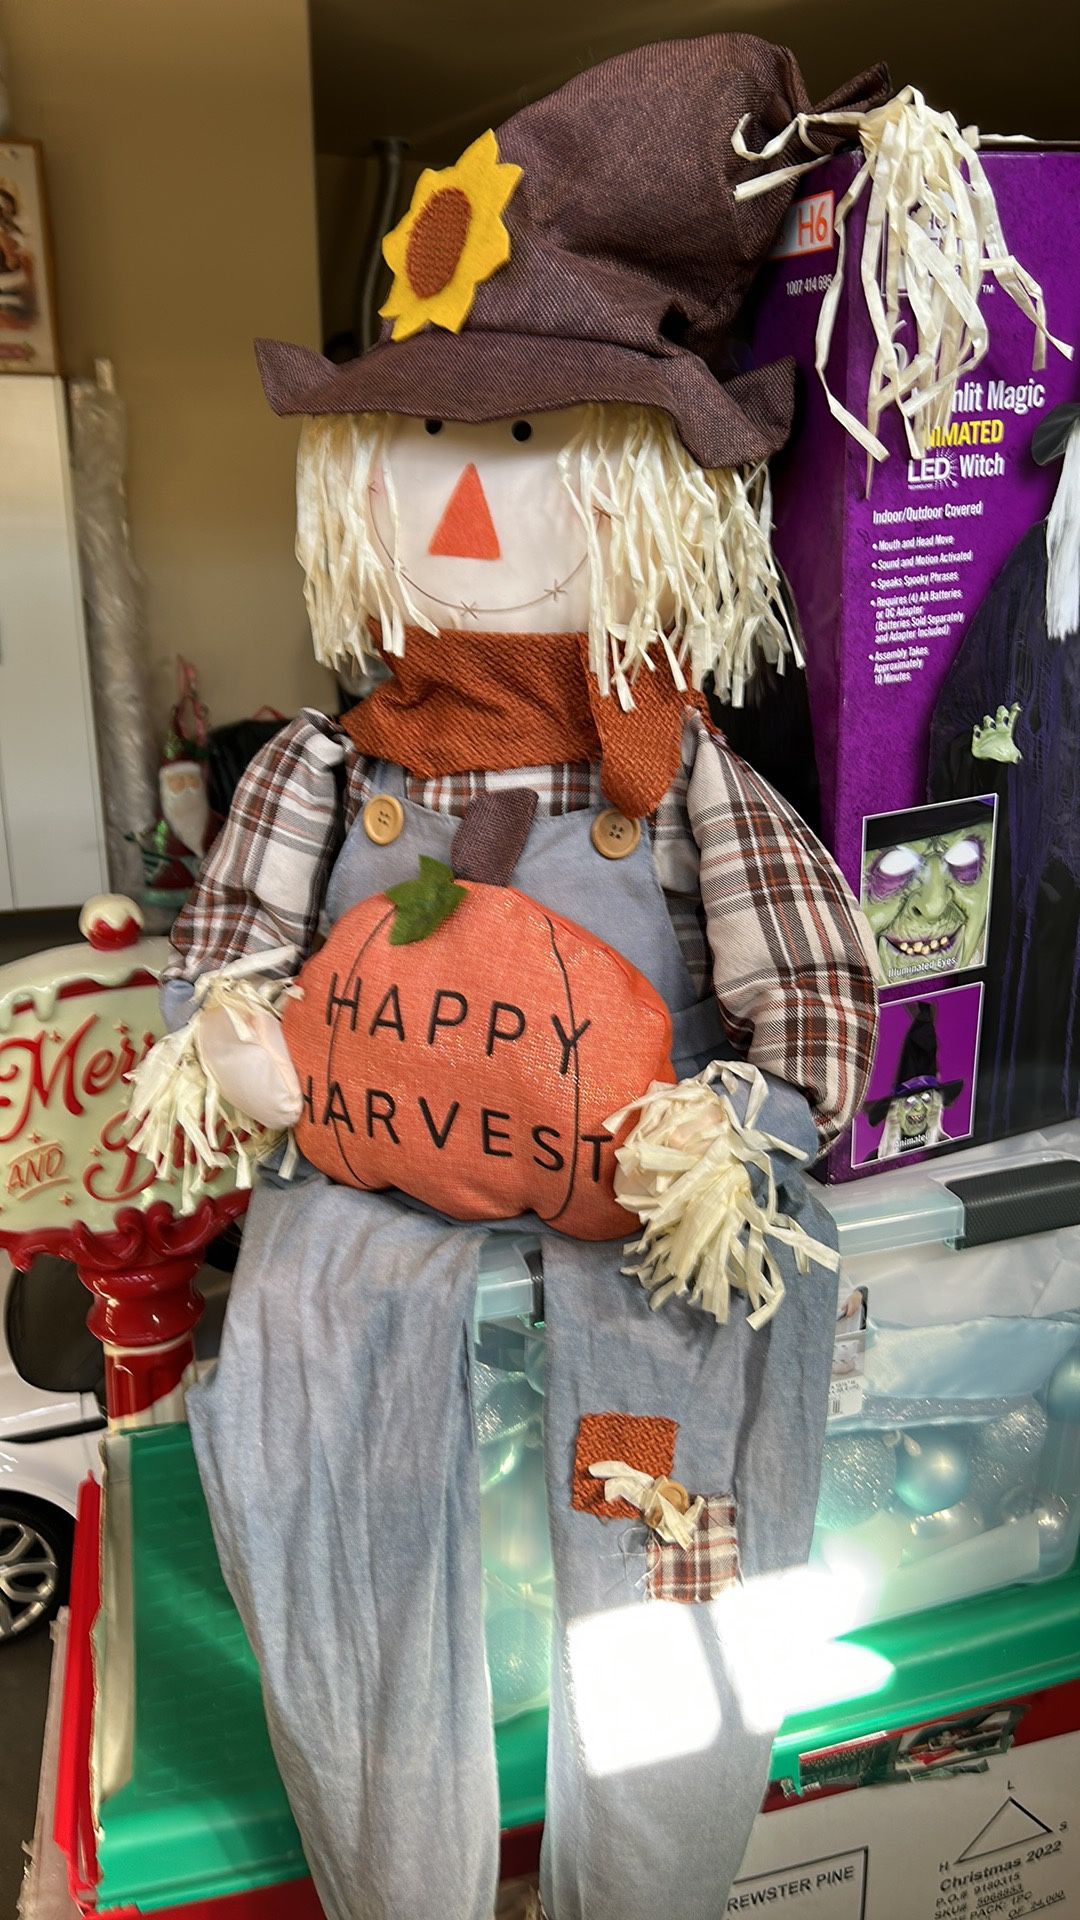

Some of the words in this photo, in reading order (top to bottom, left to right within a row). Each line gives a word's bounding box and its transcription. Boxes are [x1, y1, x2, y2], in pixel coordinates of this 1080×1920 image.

[786, 279, 803, 296] 1007
[804, 276, 817, 293] 414
[987, 378, 1046, 415] Magic
[908, 457, 950, 483] LED
[959, 452, 1005, 479] Witch
[873, 506, 943, 525] Indoor/Outdoor
[945, 500, 983, 518] Covered
[878, 539, 901, 552] Mouth
[902, 537, 915, 550] and
[916, 535, 934, 548] Head
[935, 534, 954, 546] Move
[877, 558, 900, 571] Sound
[900, 556, 914, 569] and
[915, 554, 939, 567] Motion
[940, 550, 973, 563] Activated
[877, 577, 903, 591] Speaks
[904, 574, 929, 588] Spooky
[930, 572, 959, 584] Phrases
[877, 595, 907, 608] Requires
[908, 592, 919, 604] (4)
[920, 591, 930, 602] AA
[930, 588, 963, 601] Batteries
[875, 619, 911, 633] (Batteries
[911, 616, 927, 628] Sold
[927, 611, 965, 625] Separately
[876, 610, 885, 620] or
[885, 608, 896, 619] DC
[896, 606, 923, 618] Adapter
[875, 632, 889, 645] and
[889, 629, 917, 643] Adapter
[917, 625, 951, 638] Included)
[874, 648, 908, 662] Assembly
[908, 646, 929, 657] Takes
[874, 658, 924, 674] Approximately
[874, 675, 884, 686] 10
[884, 672, 912, 684] Minutes
[888, 960, 935, 977] Illuminated
[937, 956, 956, 969] Eyes
[326, 971, 591, 1075] HAPPY
[302, 1075, 614, 1183] HARVEST
[6, 1146, 63, 1192] AND
[939, 1861, 949, 1872] H
[940, 1857, 1022, 1892] Christmas
[1025, 1840, 1062, 1863] 2022
[727, 1878, 811, 1912] REWSTER
[816, 1866, 854, 1888] PINE
